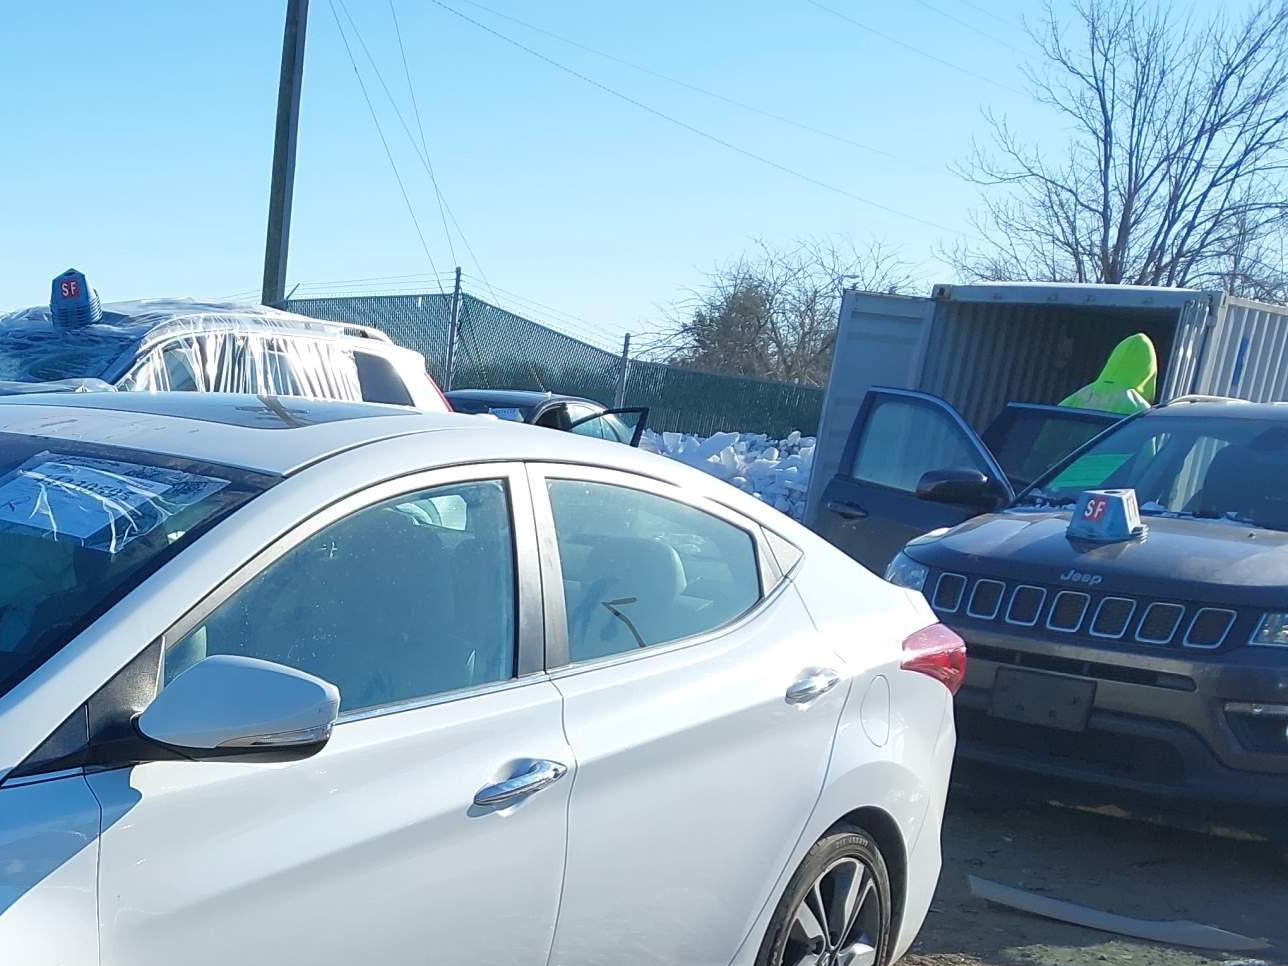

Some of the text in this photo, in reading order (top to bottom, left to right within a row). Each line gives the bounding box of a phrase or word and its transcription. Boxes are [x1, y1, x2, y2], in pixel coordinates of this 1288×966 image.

[61, 281, 77, 297] SF
[1084, 500, 1106, 518] SF
[1060, 569, 1103, 585] Jeep
